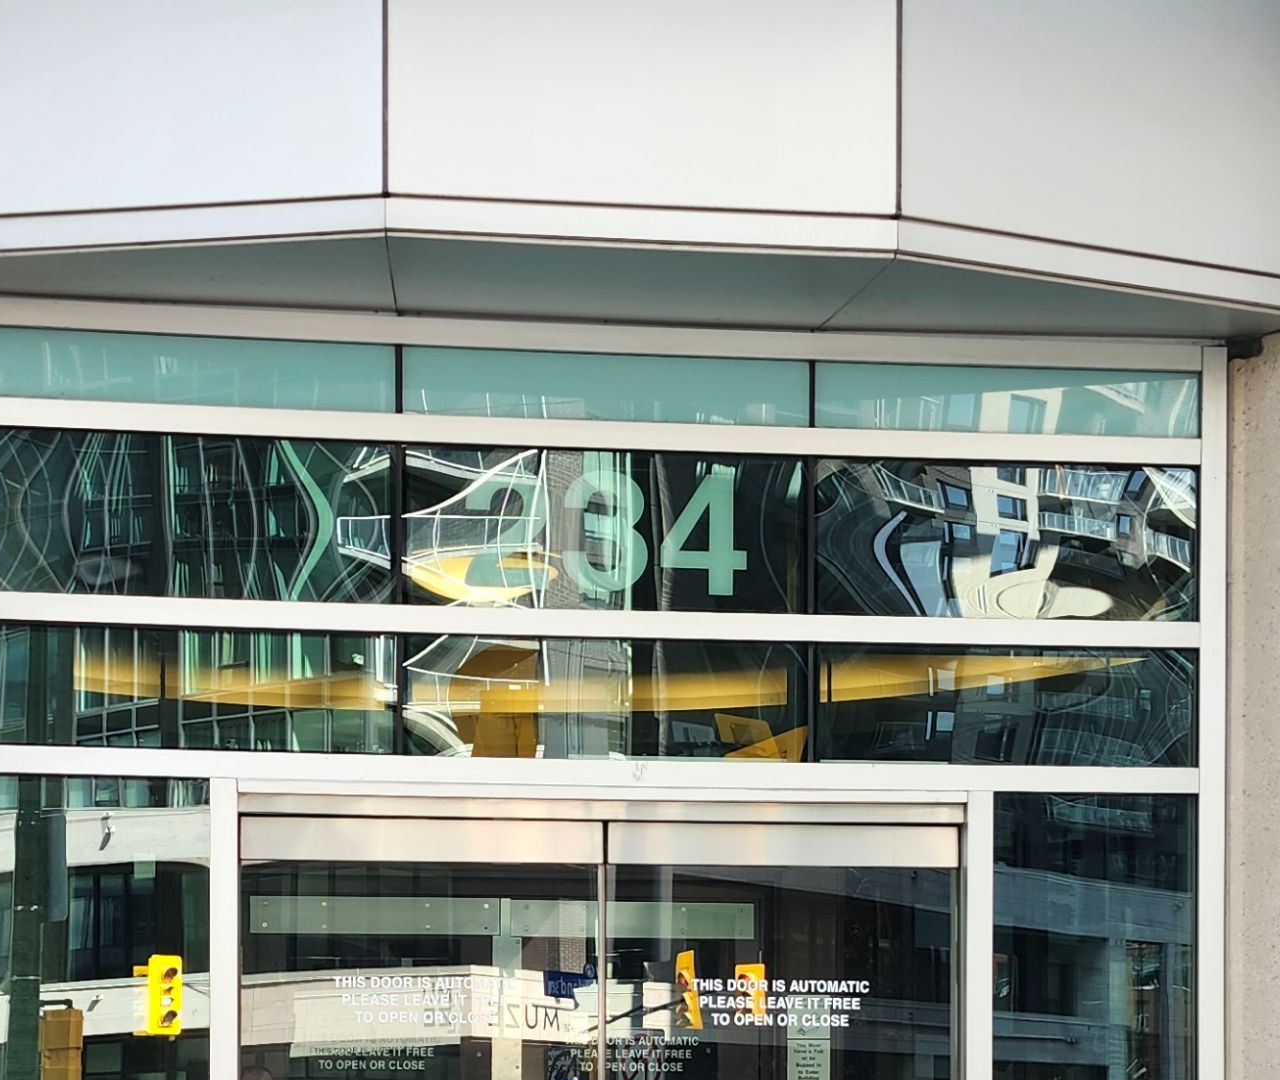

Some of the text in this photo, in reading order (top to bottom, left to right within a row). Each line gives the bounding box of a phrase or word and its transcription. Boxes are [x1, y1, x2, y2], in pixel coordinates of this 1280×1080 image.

[464, 470, 748, 596] 234
[334, 976, 366, 989] THIS
[371, 976, 413, 988] DOOR
[418, 977, 431, 989] IS
[691, 979, 870, 993] THIS DOOR IS AUTOMATIC
[341, 994, 399, 1006] PLEASE
[404, 994, 450, 1006] LEAVE
[455, 994, 467, 1006] IT
[700, 996, 861, 1010] PLEASE LEAVE IT FREE
[355, 1011, 373, 1024] TO
[378, 1011, 417, 1024] OPEN
[423, 1011, 443, 1024] OR
[711, 1013, 849, 1027] TO OPEN OR CLOSE
[592, 1036, 622, 1046] DOR
[625, 1036, 636, 1046] IS
[393, 1047, 402, 1057] IT
[406, 1047, 435, 1057] FREE
[570, 1049, 692, 1059] PLEAE LEAVE IT FREE
[318, 1060, 426, 1070] TO OPEN OR CLOSE
[580, 1062, 594, 1072] TO
[629, 1062, 644, 1072] OR
[648, 1062, 683, 1072] CLOSE
